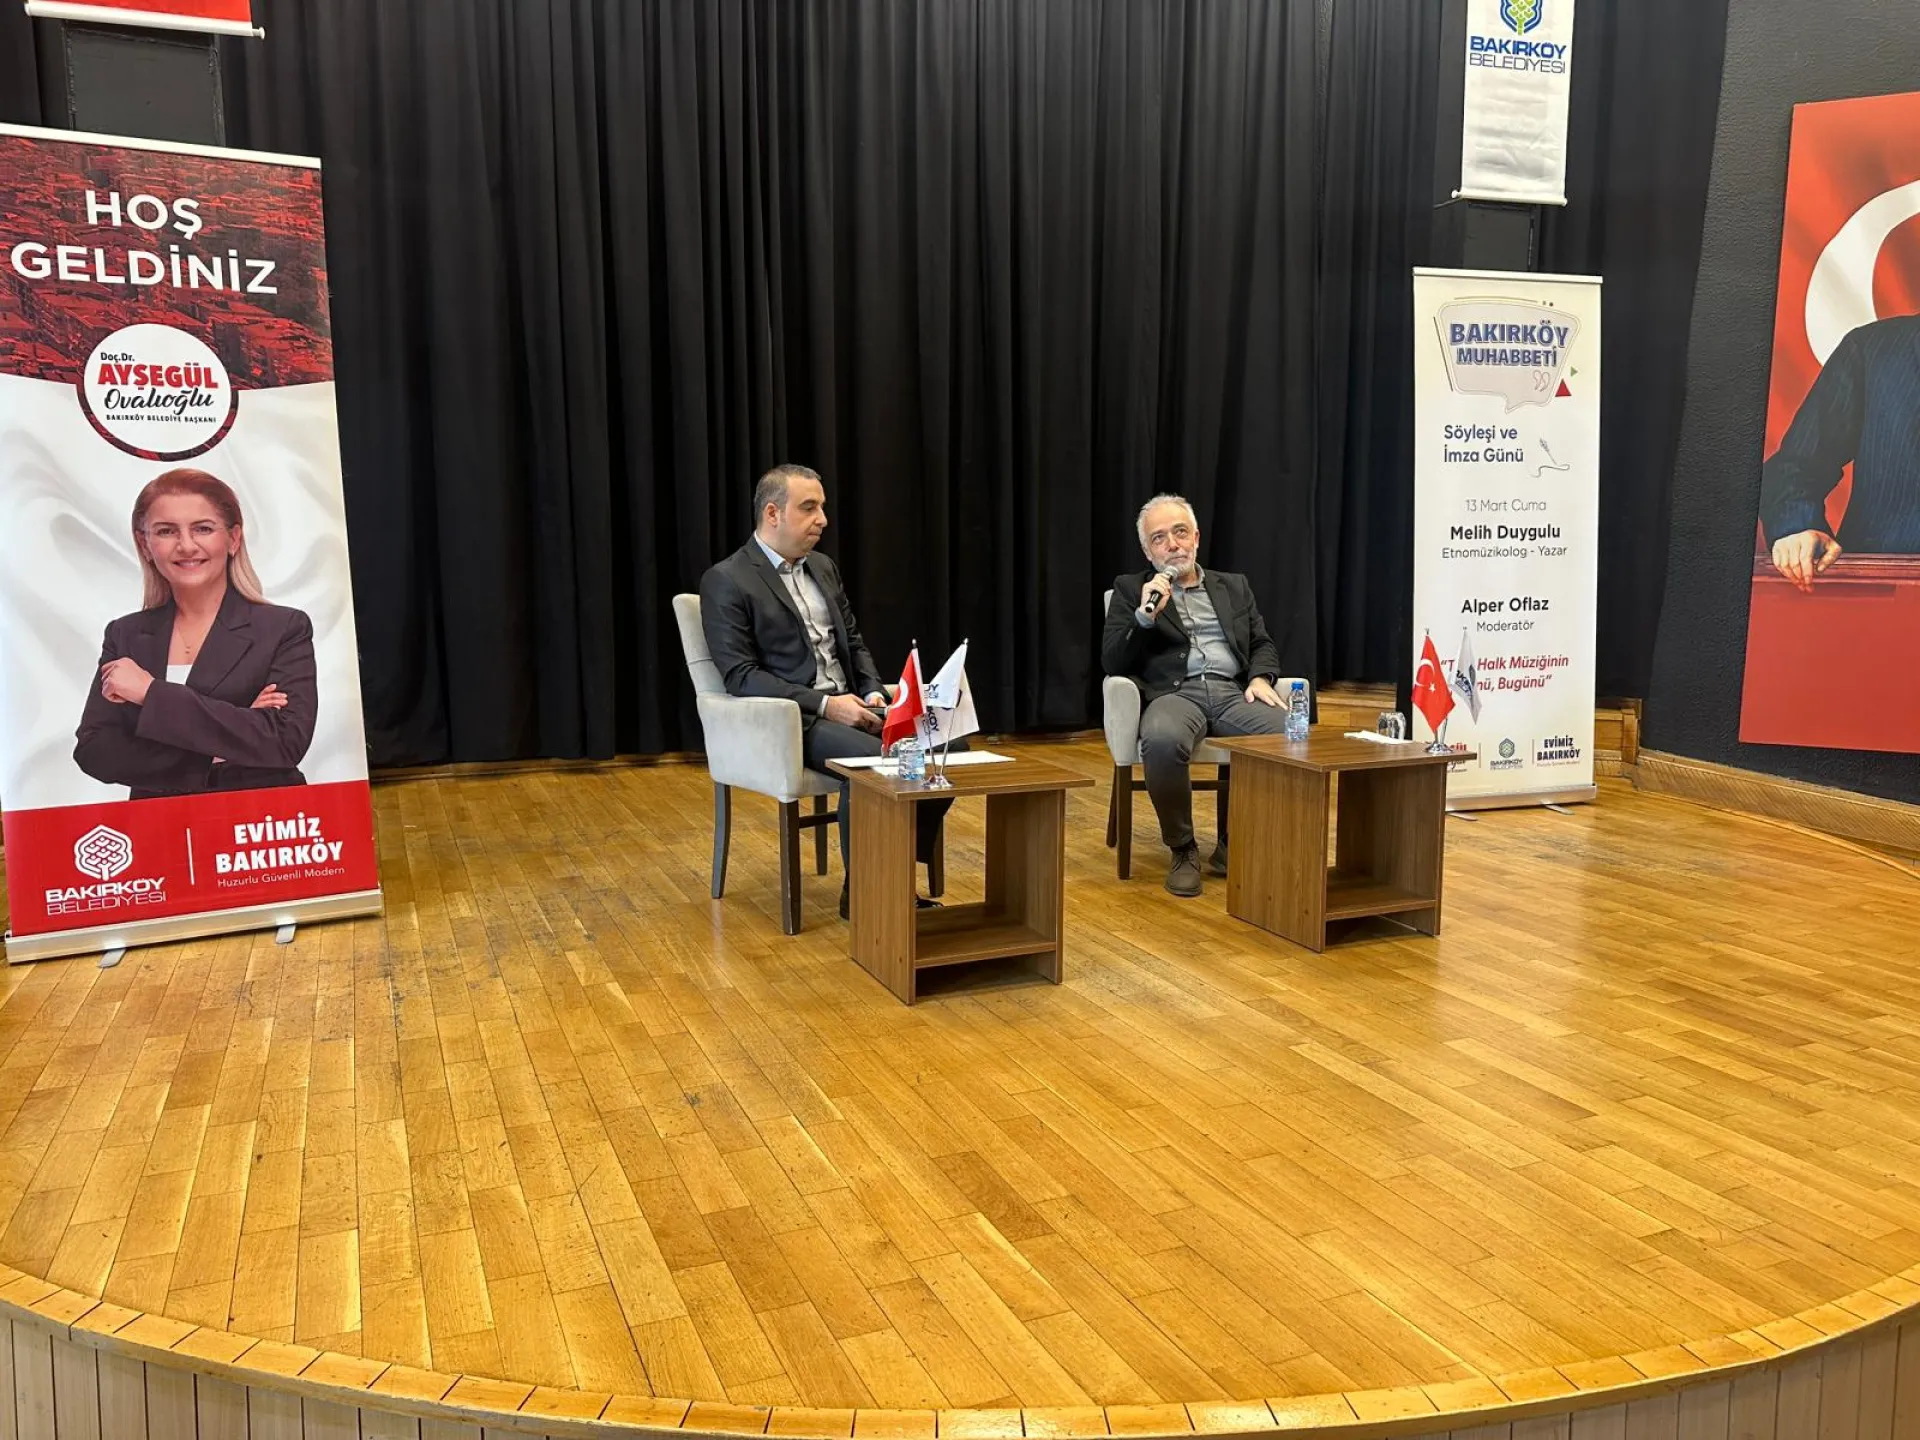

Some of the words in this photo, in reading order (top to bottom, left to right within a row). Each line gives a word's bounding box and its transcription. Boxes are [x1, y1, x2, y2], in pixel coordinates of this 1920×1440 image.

[85, 190, 203, 240] HOŞ
[11, 242, 278, 295] GELDİNİZ
[1450, 319, 1569, 348] BAKIRKÖY
[100, 352, 135, 364] Doç.Dr.
[1456, 346, 1558, 367] MUHABBETİ
[97, 362, 219, 390] AYŞEGÜL
[104, 387, 214, 416] Ovalıoğlu
[147, 414, 182, 423] BELEDİYE
[184, 416, 217, 425] BAŞKANI
[1444, 424, 1496, 443] Söyleşi
[1500, 427, 1518, 439] ve
[1444, 444, 1480, 463] İmza
[1483, 447, 1524, 463] Günü
[1465, 499, 1477, 512] 13
[1480, 499, 1508, 512] Mart
[1511, 498, 1547, 512] Cuma
[1450, 525, 1492, 540] Melih
[1497, 523, 1561, 541] Duygulu
[1442, 546, 1527, 559] Etnomüzikolog
[1538, 545, 1568, 557] Yazar
[1461, 598, 1504, 616] Alper
[1509, 596, 1549, 612] Oflaz
[1477, 620, 1535, 632] Moderatör
[1477, 656, 1507, 671] Halk
[1509, 653, 1569, 671] Müziğinin
[1543, 735, 1574, 749] EVİMİZ
[1537, 746, 1581, 761] BAKIRKÖY
[234, 811, 321, 845] EVİMİZ
[215, 837, 343, 874] BAKIRKÖY
[217, 875, 259, 888] Huzurlu
[261, 870, 301, 883] Güvenli
[304, 866, 345, 878] Modern
